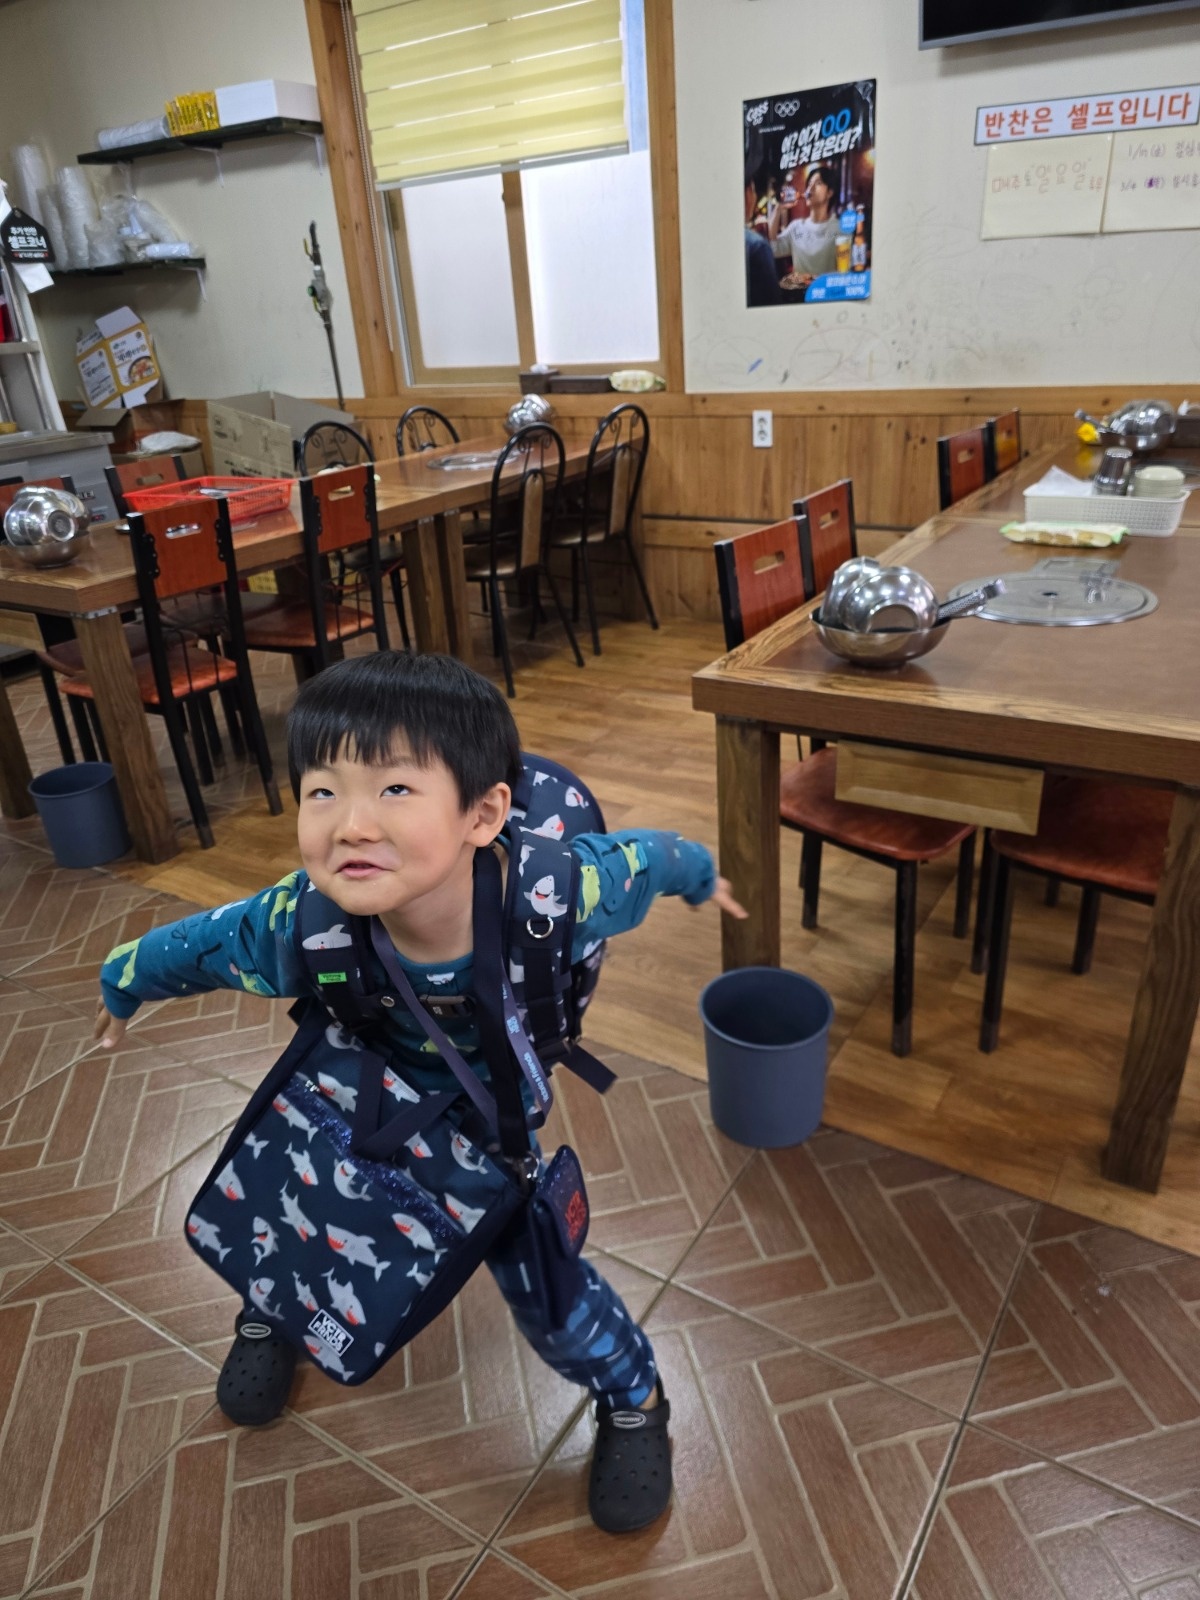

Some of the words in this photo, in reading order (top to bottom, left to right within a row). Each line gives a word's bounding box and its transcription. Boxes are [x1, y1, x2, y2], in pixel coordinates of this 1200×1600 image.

[984, 107, 1052, 138] 반찬은
[1067, 92, 1191, 131] 셀프입니다
[8, 236, 47, 249] 셀프코너
[312, 1320, 343, 1351] FRNDS
